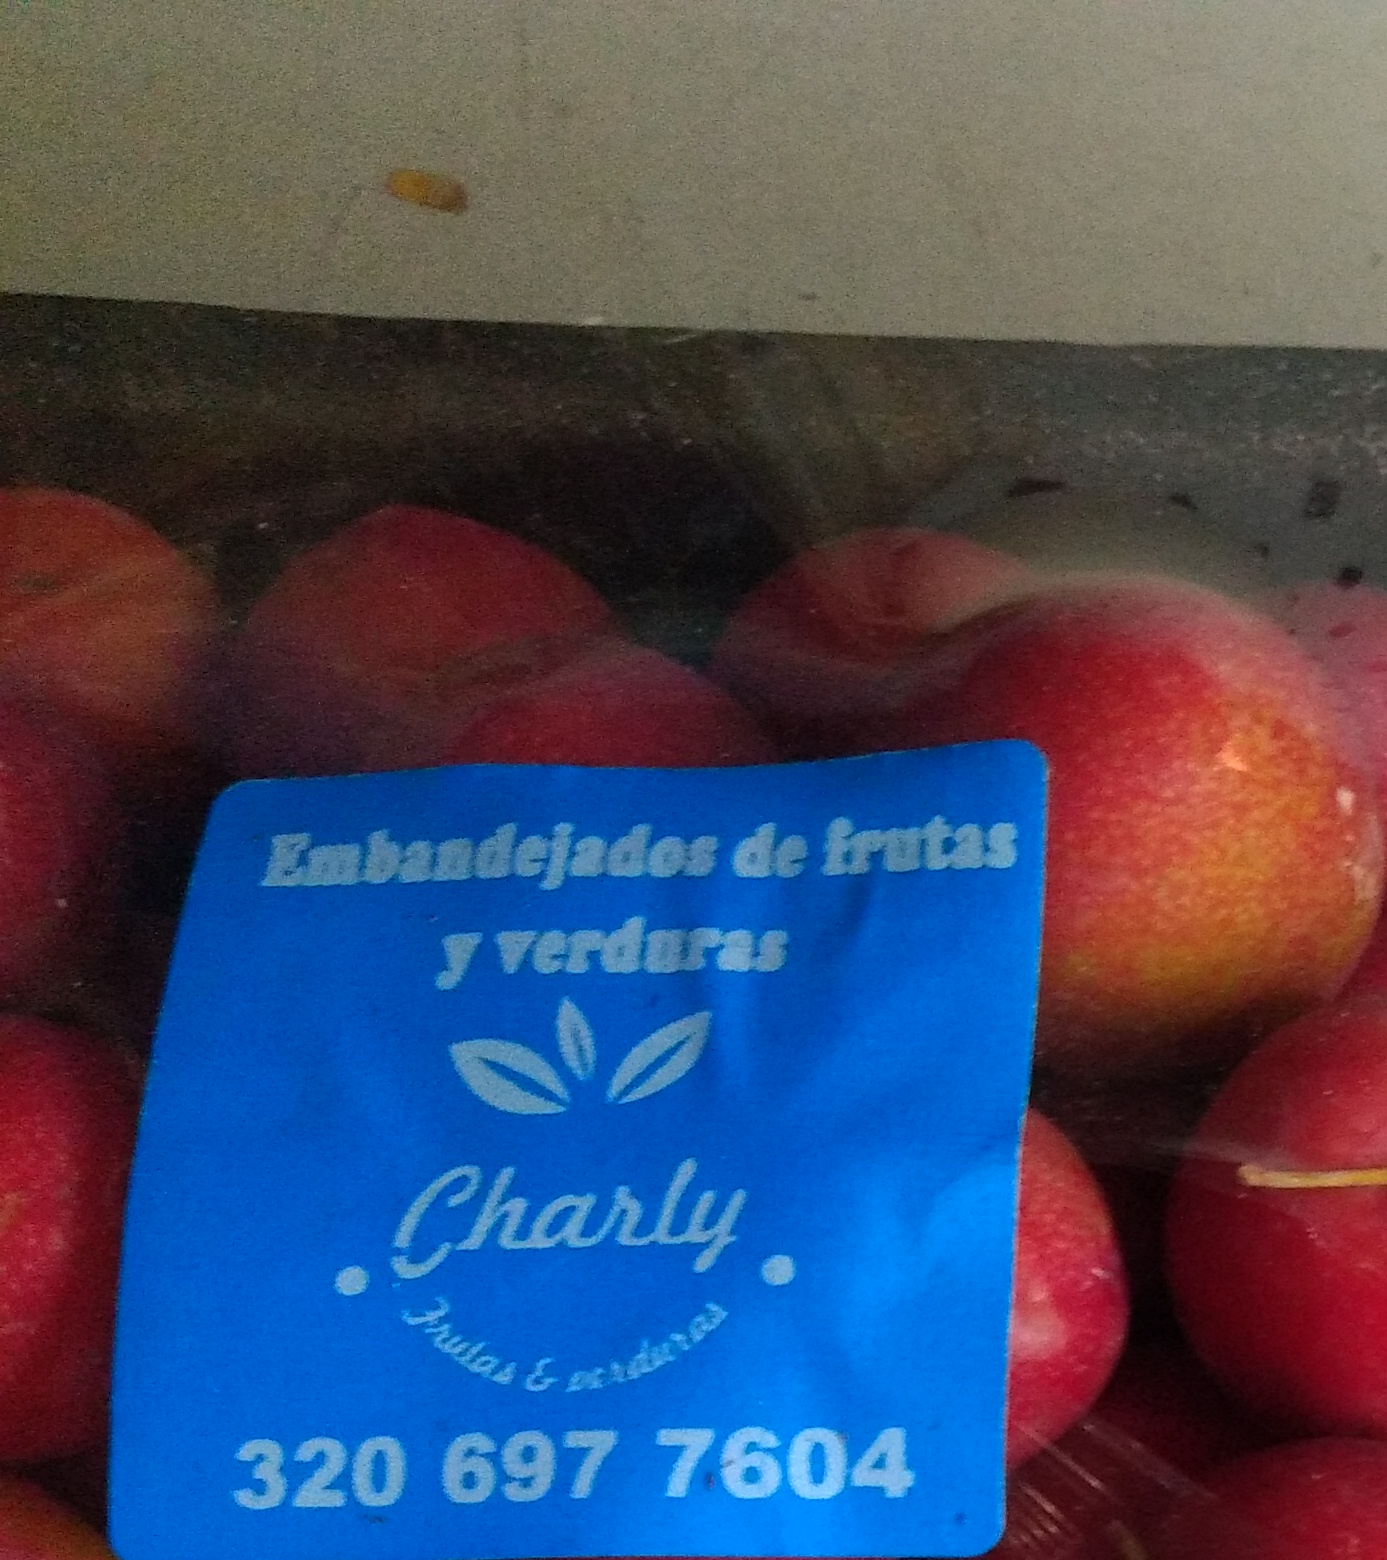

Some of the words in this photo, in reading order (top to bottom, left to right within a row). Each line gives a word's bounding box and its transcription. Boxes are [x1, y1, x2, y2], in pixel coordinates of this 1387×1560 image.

[260, 822, 718, 890] Embandejados
[732, 822, 808, 878] de
[820, 815, 1018, 876] frutas
[434, 931, 483, 990] y
[495, 915, 788, 974] verduras
[391, 1157, 747, 1279] Charly
[402, 1297, 517, 1385] Frutas
[525, 1357, 558, 1391] &
[233, 1436, 406, 1509] 320
[441, 1431, 618, 1503] 697
[655, 1426, 916, 1499] 7604
